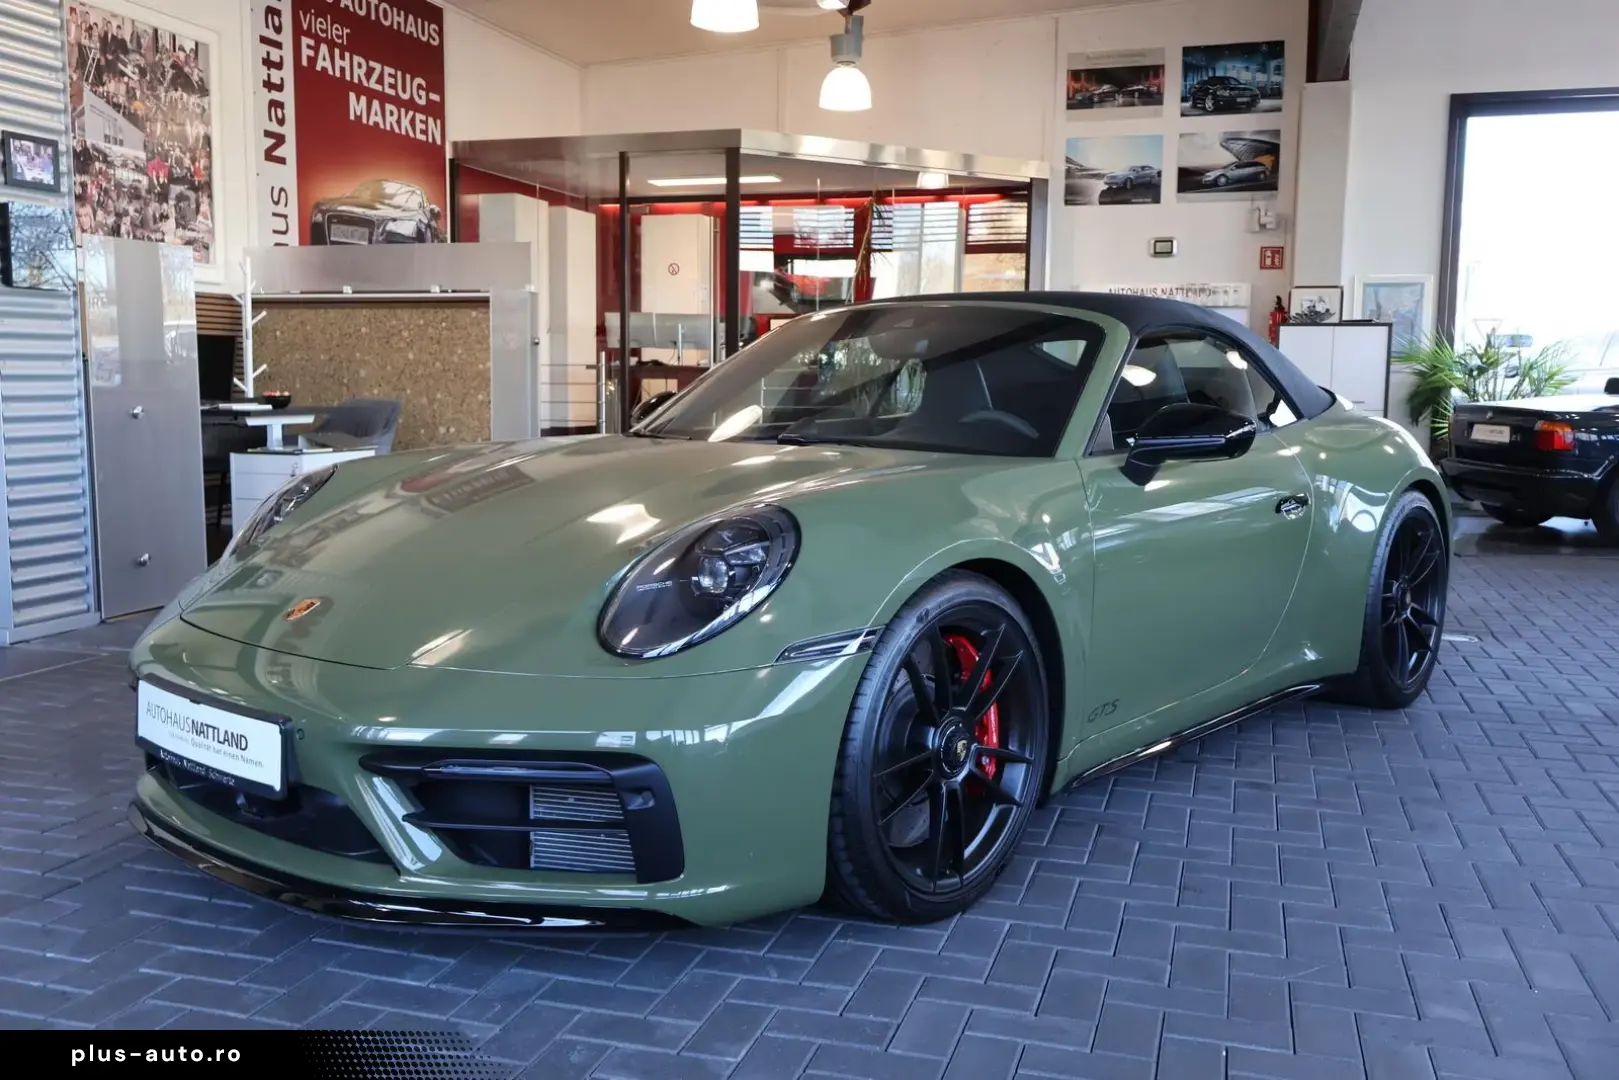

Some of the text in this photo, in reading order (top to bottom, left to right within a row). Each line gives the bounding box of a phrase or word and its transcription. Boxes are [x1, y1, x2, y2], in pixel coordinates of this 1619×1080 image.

[299, 9, 350, 45] vieler
[340, 0, 440, 46] AUTOHAUS
[300, 35, 440, 105] FAHRZEUG-
[259, 0, 289, 247] us Nattla
[349, 91, 441, 145] MARKEN
[1087, 698, 1120, 723] GTS
